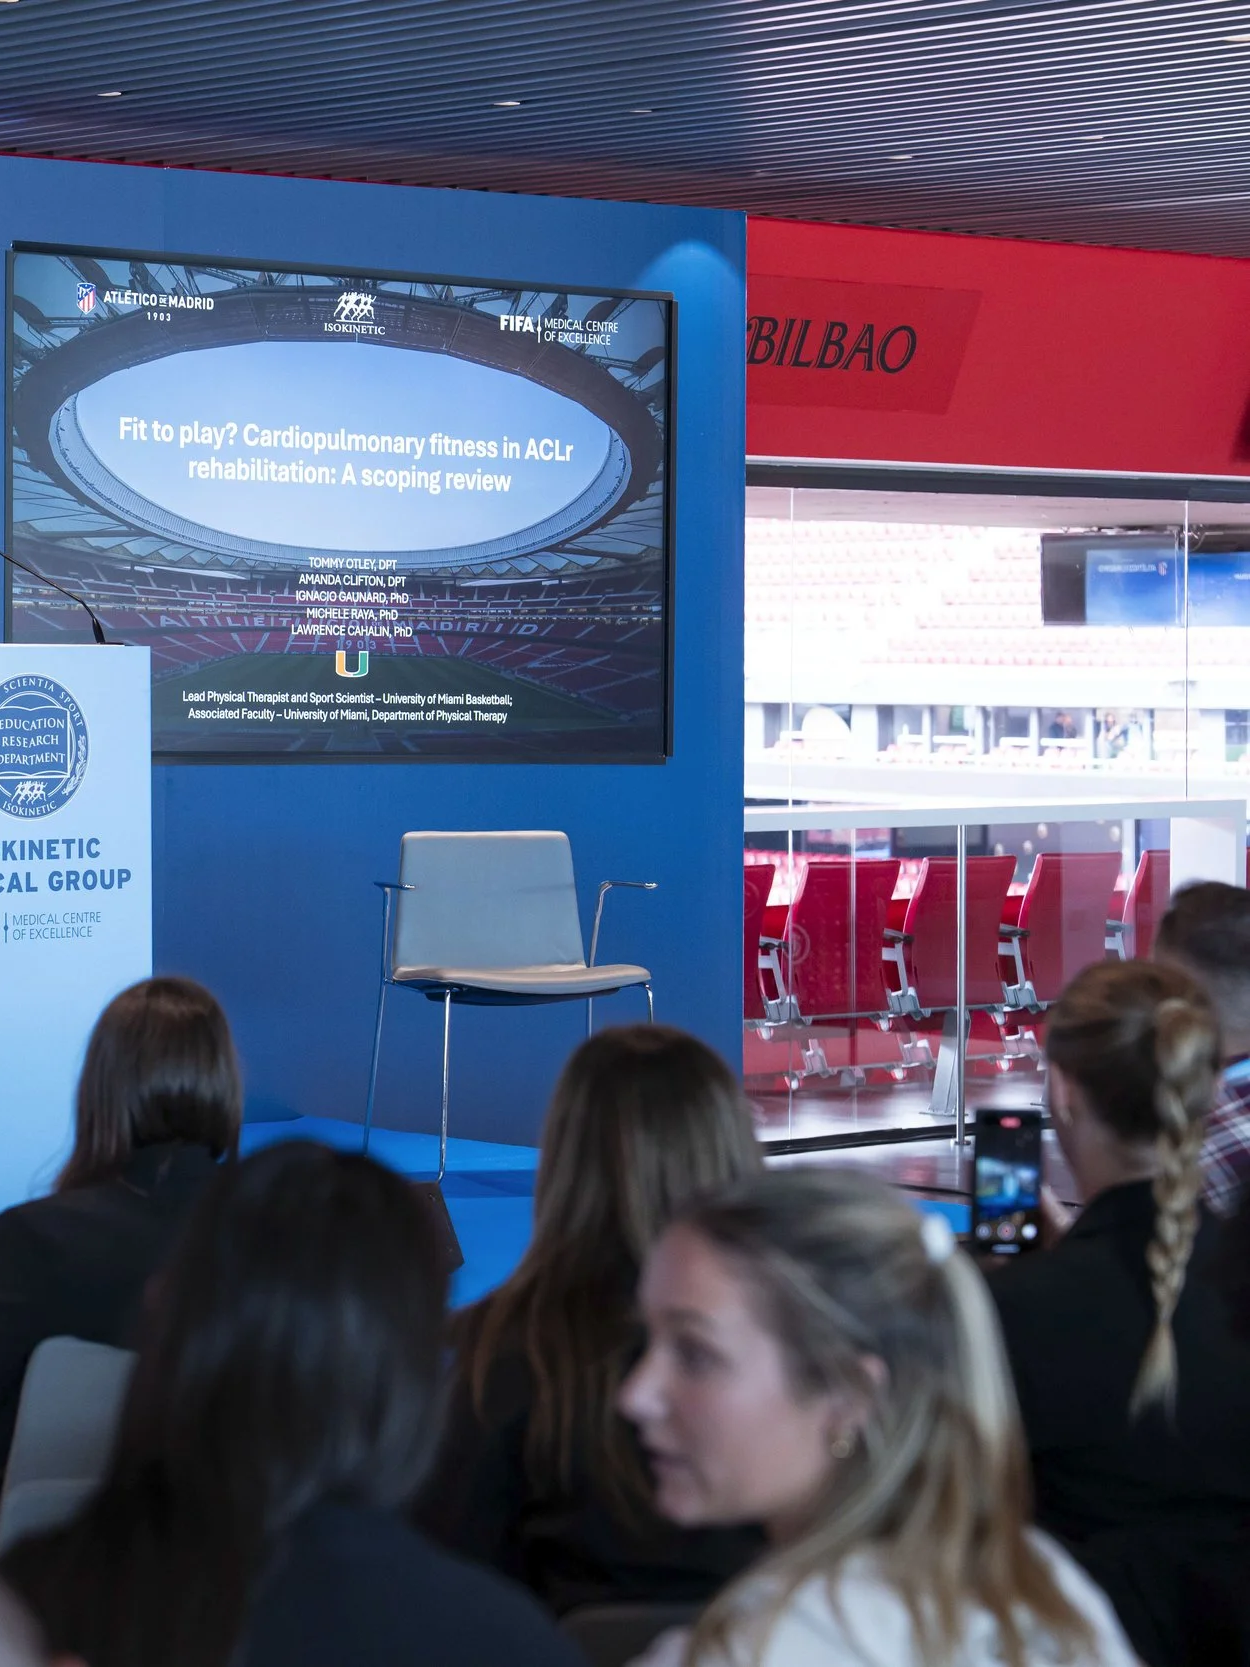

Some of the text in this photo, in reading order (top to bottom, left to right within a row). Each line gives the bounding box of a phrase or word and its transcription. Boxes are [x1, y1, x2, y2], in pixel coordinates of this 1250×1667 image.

[103, 289, 157, 307] ATLÉTICO
[168, 295, 215, 311] MADRID
[147, 311, 171, 322] 1903
[500, 314, 535, 333] FIFA
[324, 322, 386, 336] ISOKINETIC
[544, 317, 619, 334] MEDICAL CENTRE
[544, 330, 611, 346] OF EXCELLENCE
[747, 315, 917, 374] BILBAO
[119, 416, 574, 462] Fit to play? Cardiopulmonary fitness in ACLr
[188, 456, 512, 495] rehabilitation: A scoping review
[308, 556, 398, 572] TOMMY OTLEY, DPT
[298, 573, 407, 588] AMANDA CLIFTON, DPT
[295, 590, 410, 606] IGNACIO GAUNARD, PhD
[306, 607, 399, 622] MICHELE RAYA, PhD
[291, 623, 413, 639] LAWRENCE CAHALIN, PhD
[3, 677, 55, 693] SCIENTIA
[59, 691, 84, 728] SPORT
[182, 690, 206, 702] Lead
[207, 691, 246, 705] Physical
[247, 691, 290, 705] Therapist
[290, 692, 308, 703] and
[309, 692, 335, 705] Sport
[335, 692, 375, 704] Scientist
[382, 692, 426, 707] University
[427, 693, 437, 704] of
[438, 693, 464, 705] Miami
[465, 694, 513, 706] Basketball;
[188, 707, 240, 719] Associated
[241, 708, 276, 722] Faculty
[283, 708, 328, 722] University
[329, 709, 340, 720] of
[340, 709, 370, 722] Miami,
[371, 709, 424, 722] Department
[426, 710, 436, 721] of
[436, 710, 472, 723] Physical
[473, 710, 508, 724] Therapy
[2, 734, 59, 748] RESEARCH
[2, 800, 57, 817] ISOKINETIC
[48, 868, 132, 892] GROUP
[12, 911, 102, 926] MEDICAL CENTRE
[12, 926, 93, 941] OF EXCELLENCE
